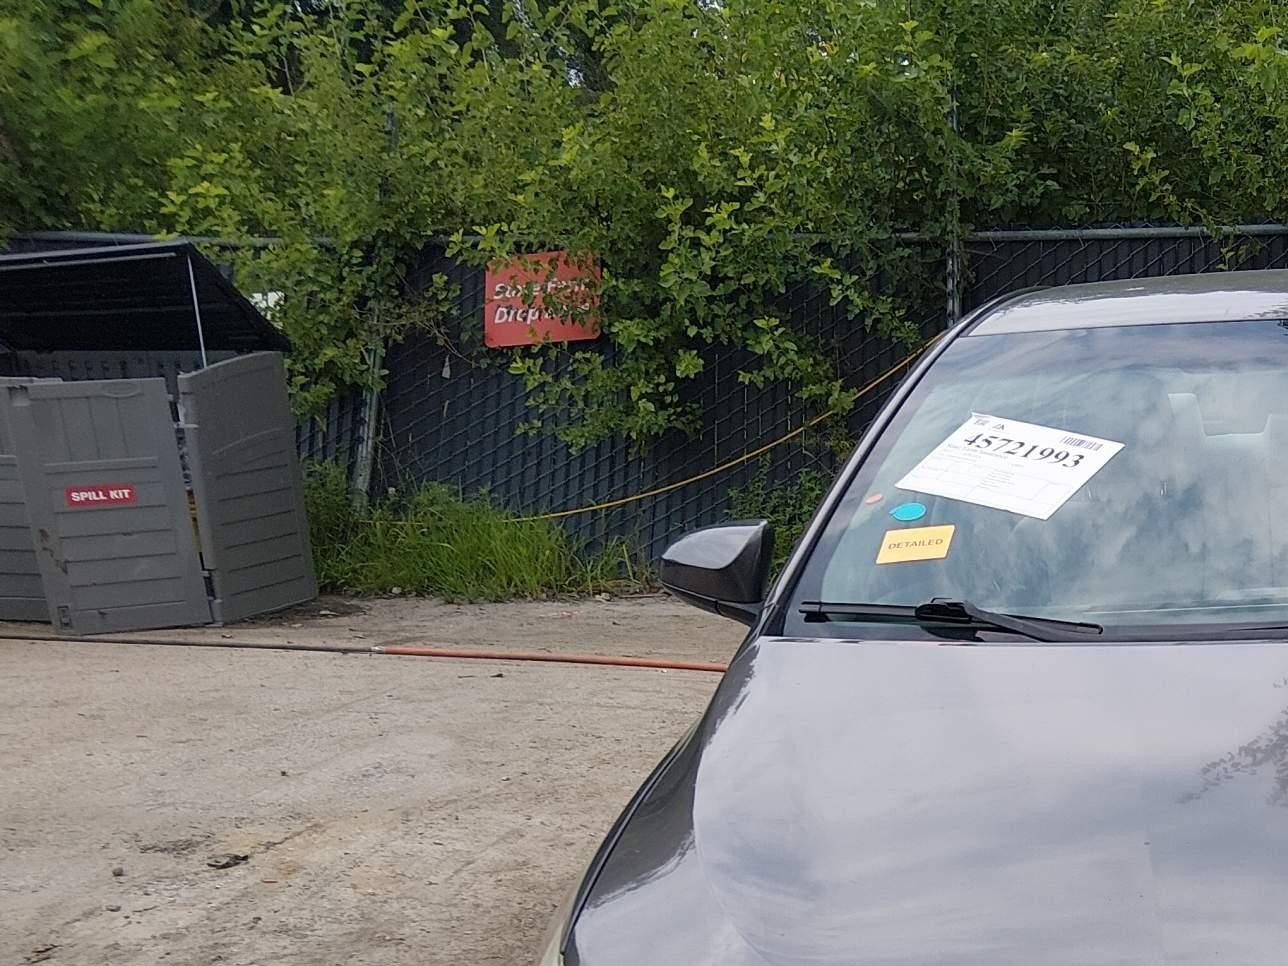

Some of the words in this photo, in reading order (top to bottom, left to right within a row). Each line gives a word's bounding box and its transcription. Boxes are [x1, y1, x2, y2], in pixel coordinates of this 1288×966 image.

[493, 283, 542, 299] Stae
[964, 432, 1086, 468] 45721993
[71, 490, 108, 502] SPILL
[109, 489, 132, 500] KIT
[888, 538, 944, 550] DETAILED
